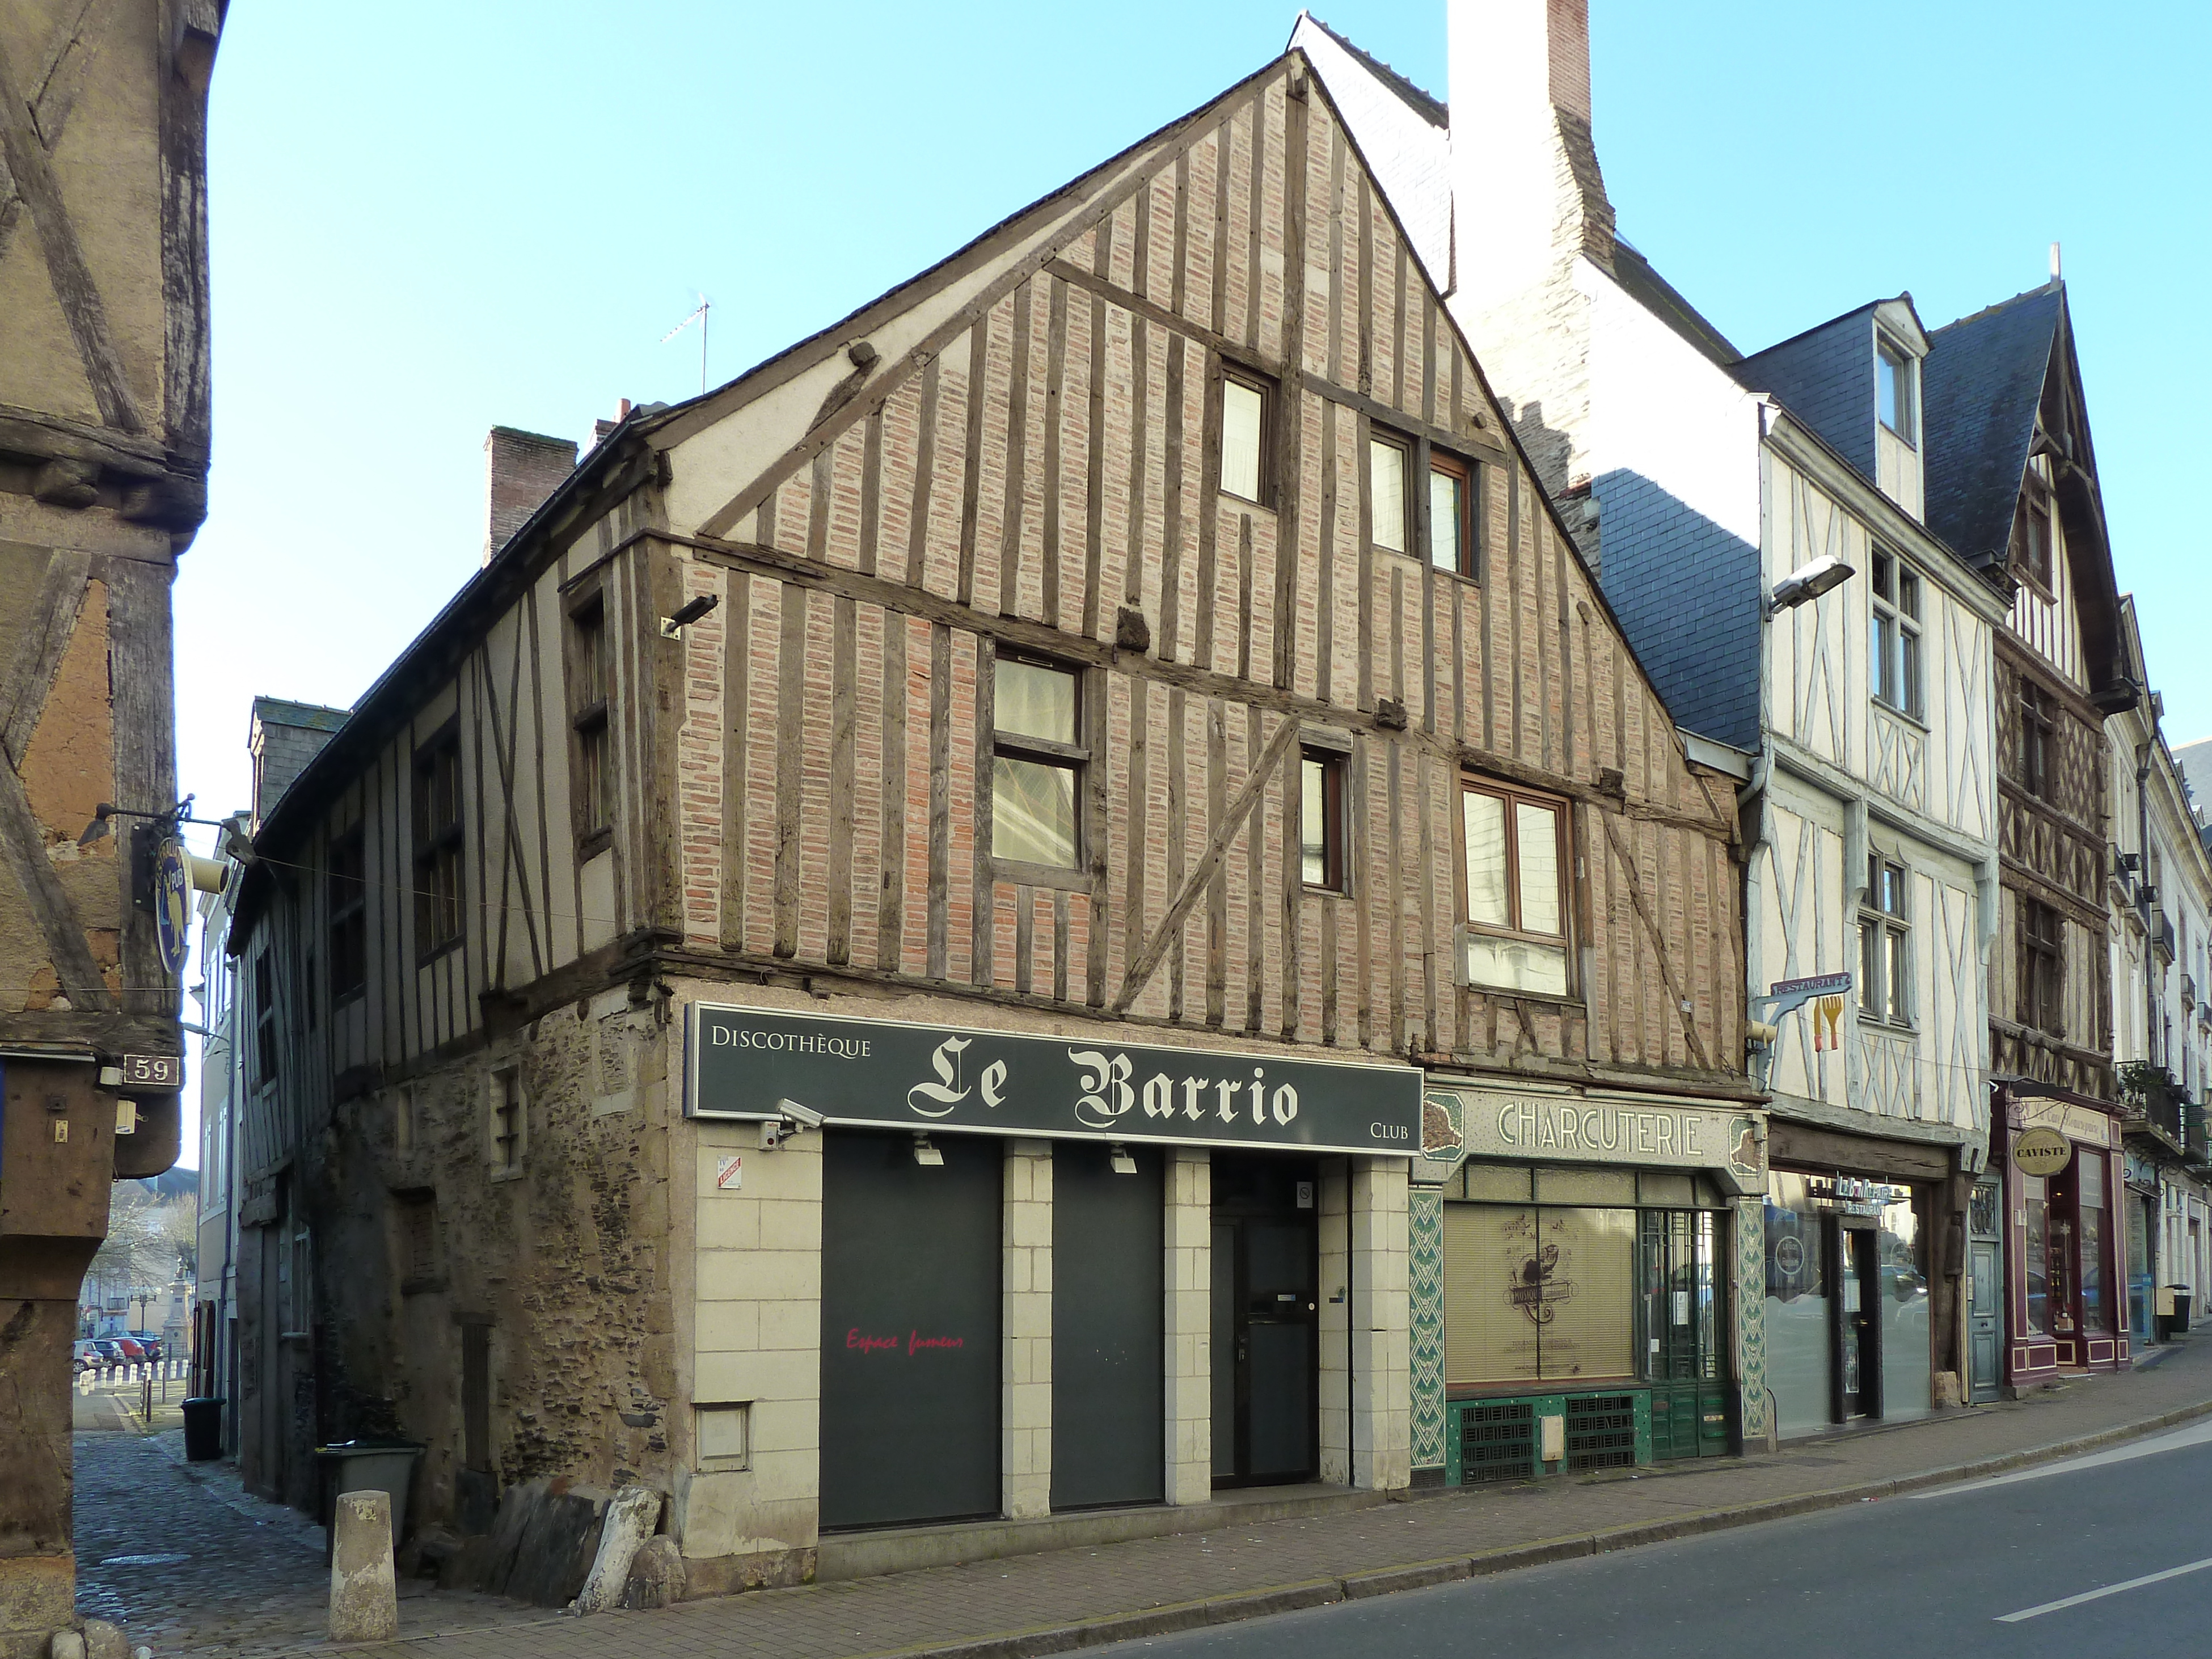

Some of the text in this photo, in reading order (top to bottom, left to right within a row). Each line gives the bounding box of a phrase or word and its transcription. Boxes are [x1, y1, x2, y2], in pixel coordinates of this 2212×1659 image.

[172, 868, 183, 890] PUB
[1777, 977, 1843, 994] RESTAURANT
[134, 1059, 168, 1081] 59
[907, 1035, 1298, 1129] Le Barrio
[1498, 1101, 1703, 1156] CHARCUTERIE
[2016, 1146, 2067, 1158] CAVISTE
[720, 1160, 739, 1184] LICENCE
[1846, 1203, 1882, 1216] RESTAURANT
[846, 1328, 899, 1354] Espace
